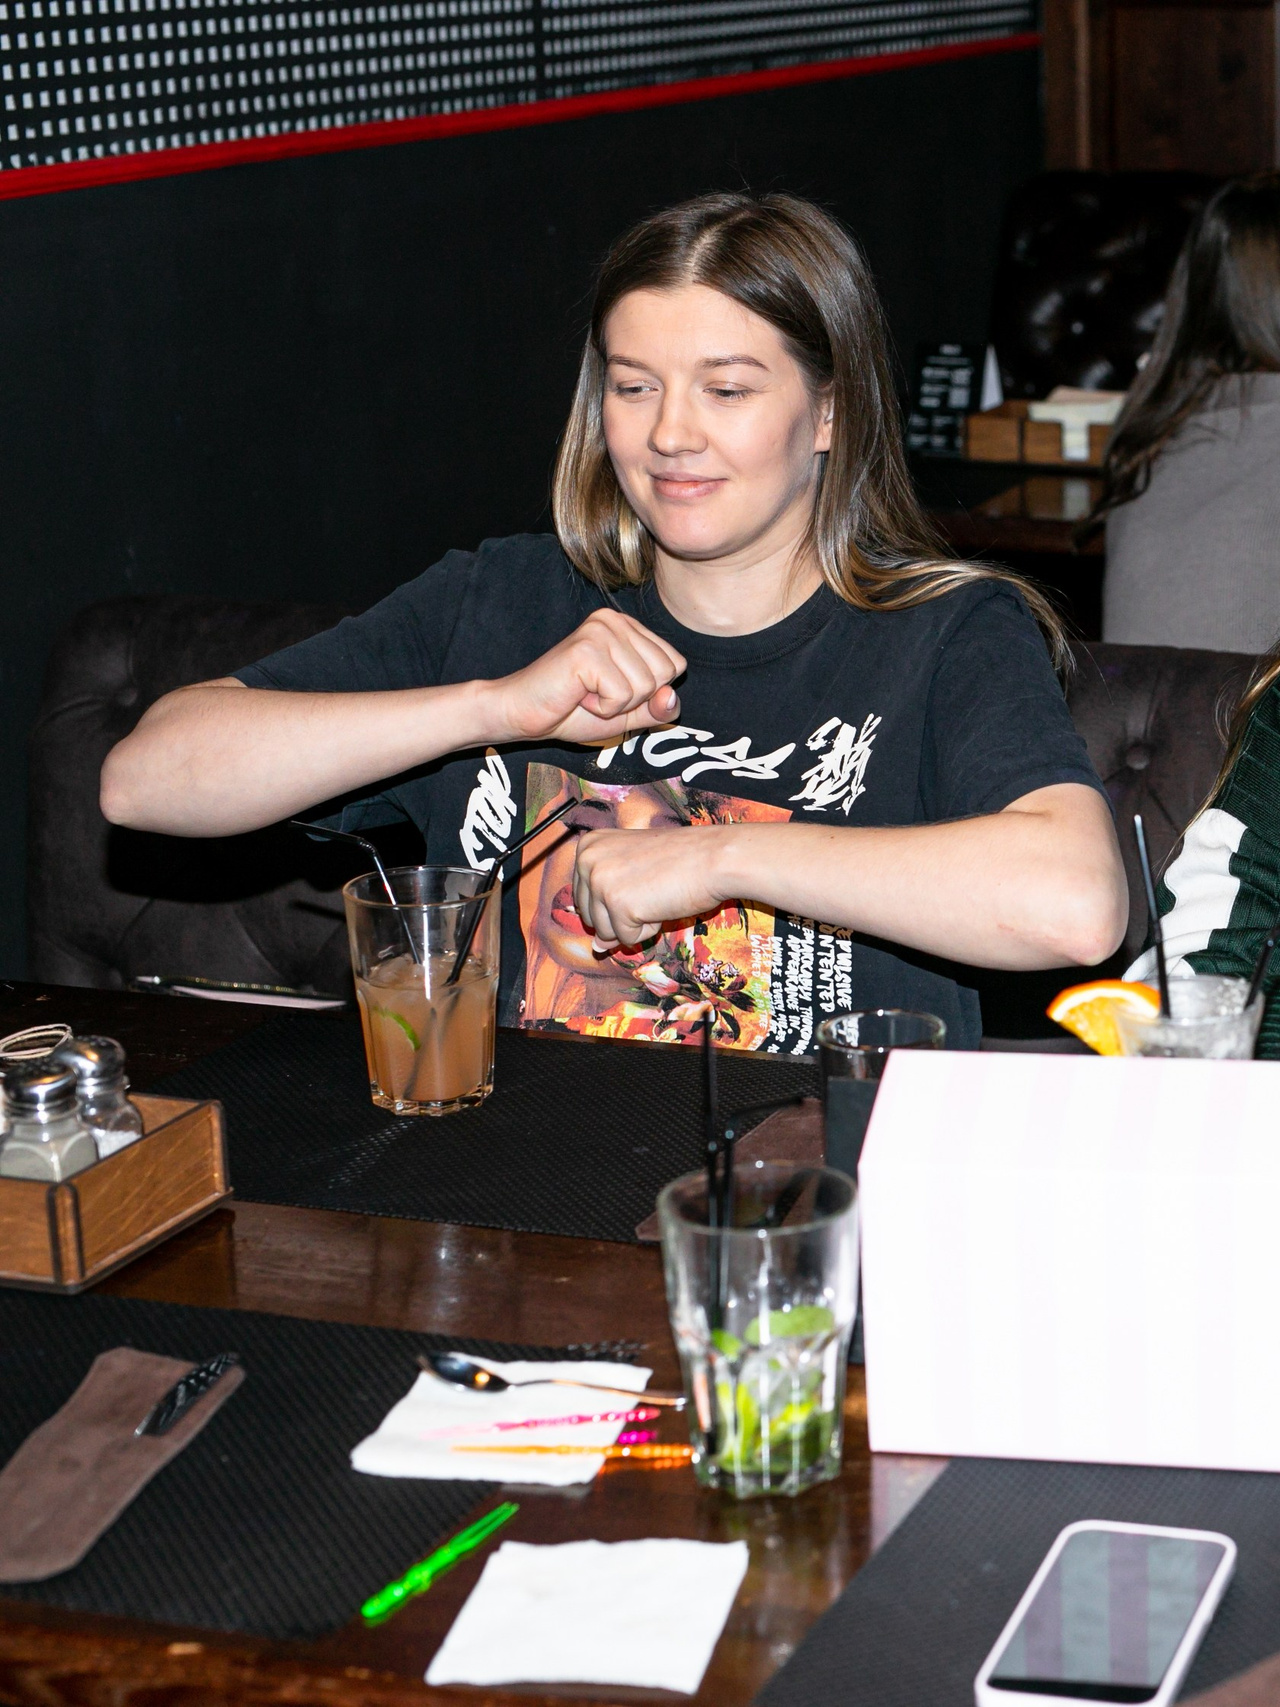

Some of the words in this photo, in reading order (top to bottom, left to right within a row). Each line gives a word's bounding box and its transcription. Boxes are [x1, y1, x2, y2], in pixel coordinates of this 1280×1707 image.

[772, 981, 785, 1012] EVERY
[785, 934, 801, 1012] APPEARANCE
[816, 922, 836, 1012] ONTENTED
[834, 927, 854, 1011] EPULSIVE
